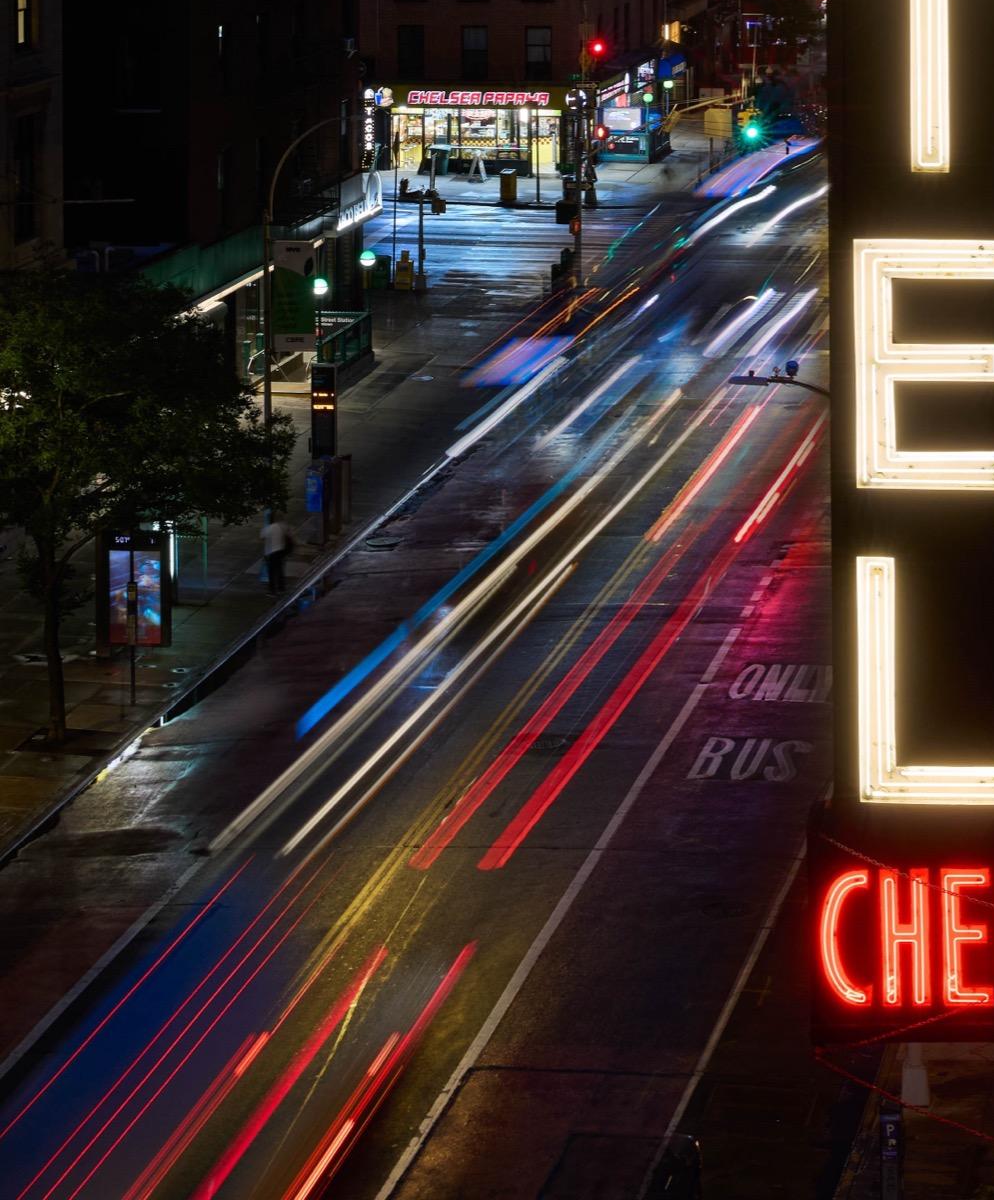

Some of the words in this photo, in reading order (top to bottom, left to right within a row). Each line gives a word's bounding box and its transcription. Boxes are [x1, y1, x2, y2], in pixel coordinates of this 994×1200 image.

[407, 90, 482, 105] CHELSEA
[363, 106, 375, 151] TACOS
[686, 736, 815, 782] BUS
